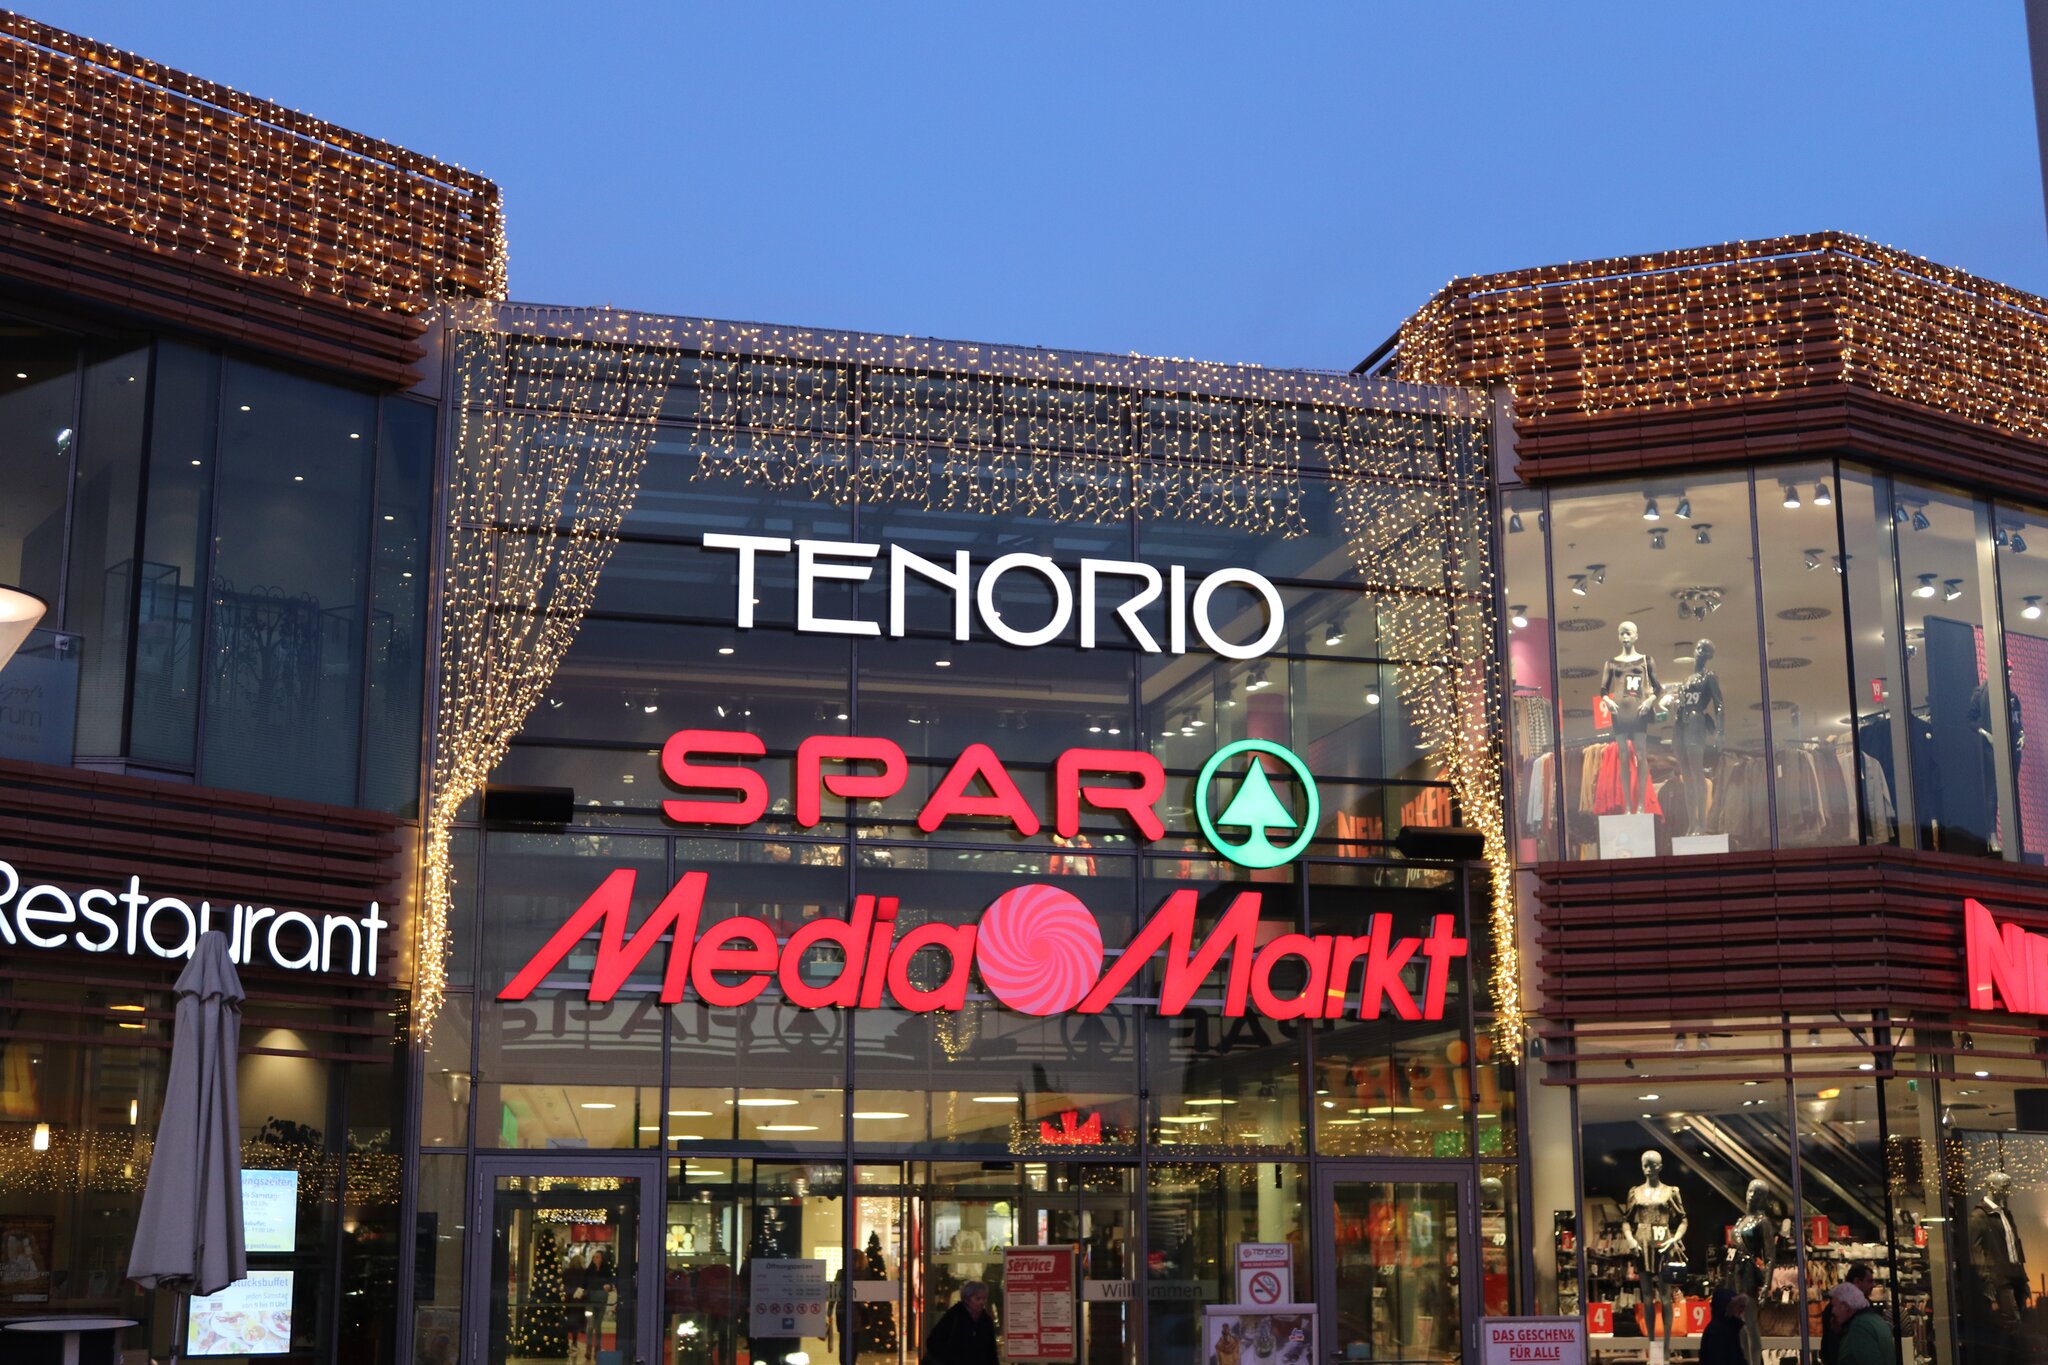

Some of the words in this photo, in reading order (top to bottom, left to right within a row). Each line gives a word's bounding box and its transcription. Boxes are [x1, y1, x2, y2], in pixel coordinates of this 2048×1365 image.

[703, 532, 1286, 661] TENORIO
[662, 730, 1166, 841] SPAR
[499, 868, 978, 1012] Media
[1078, 889, 1468, 1020] Markt
[1008, 1258, 1052, 1272] Service
[1492, 1329, 1515, 1341] DAS
[1518, 1329, 1575, 1341] GESCHENK
[1510, 1344, 1531, 1359] FÜR
[1535, 1346, 1560, 1358] ALLE
